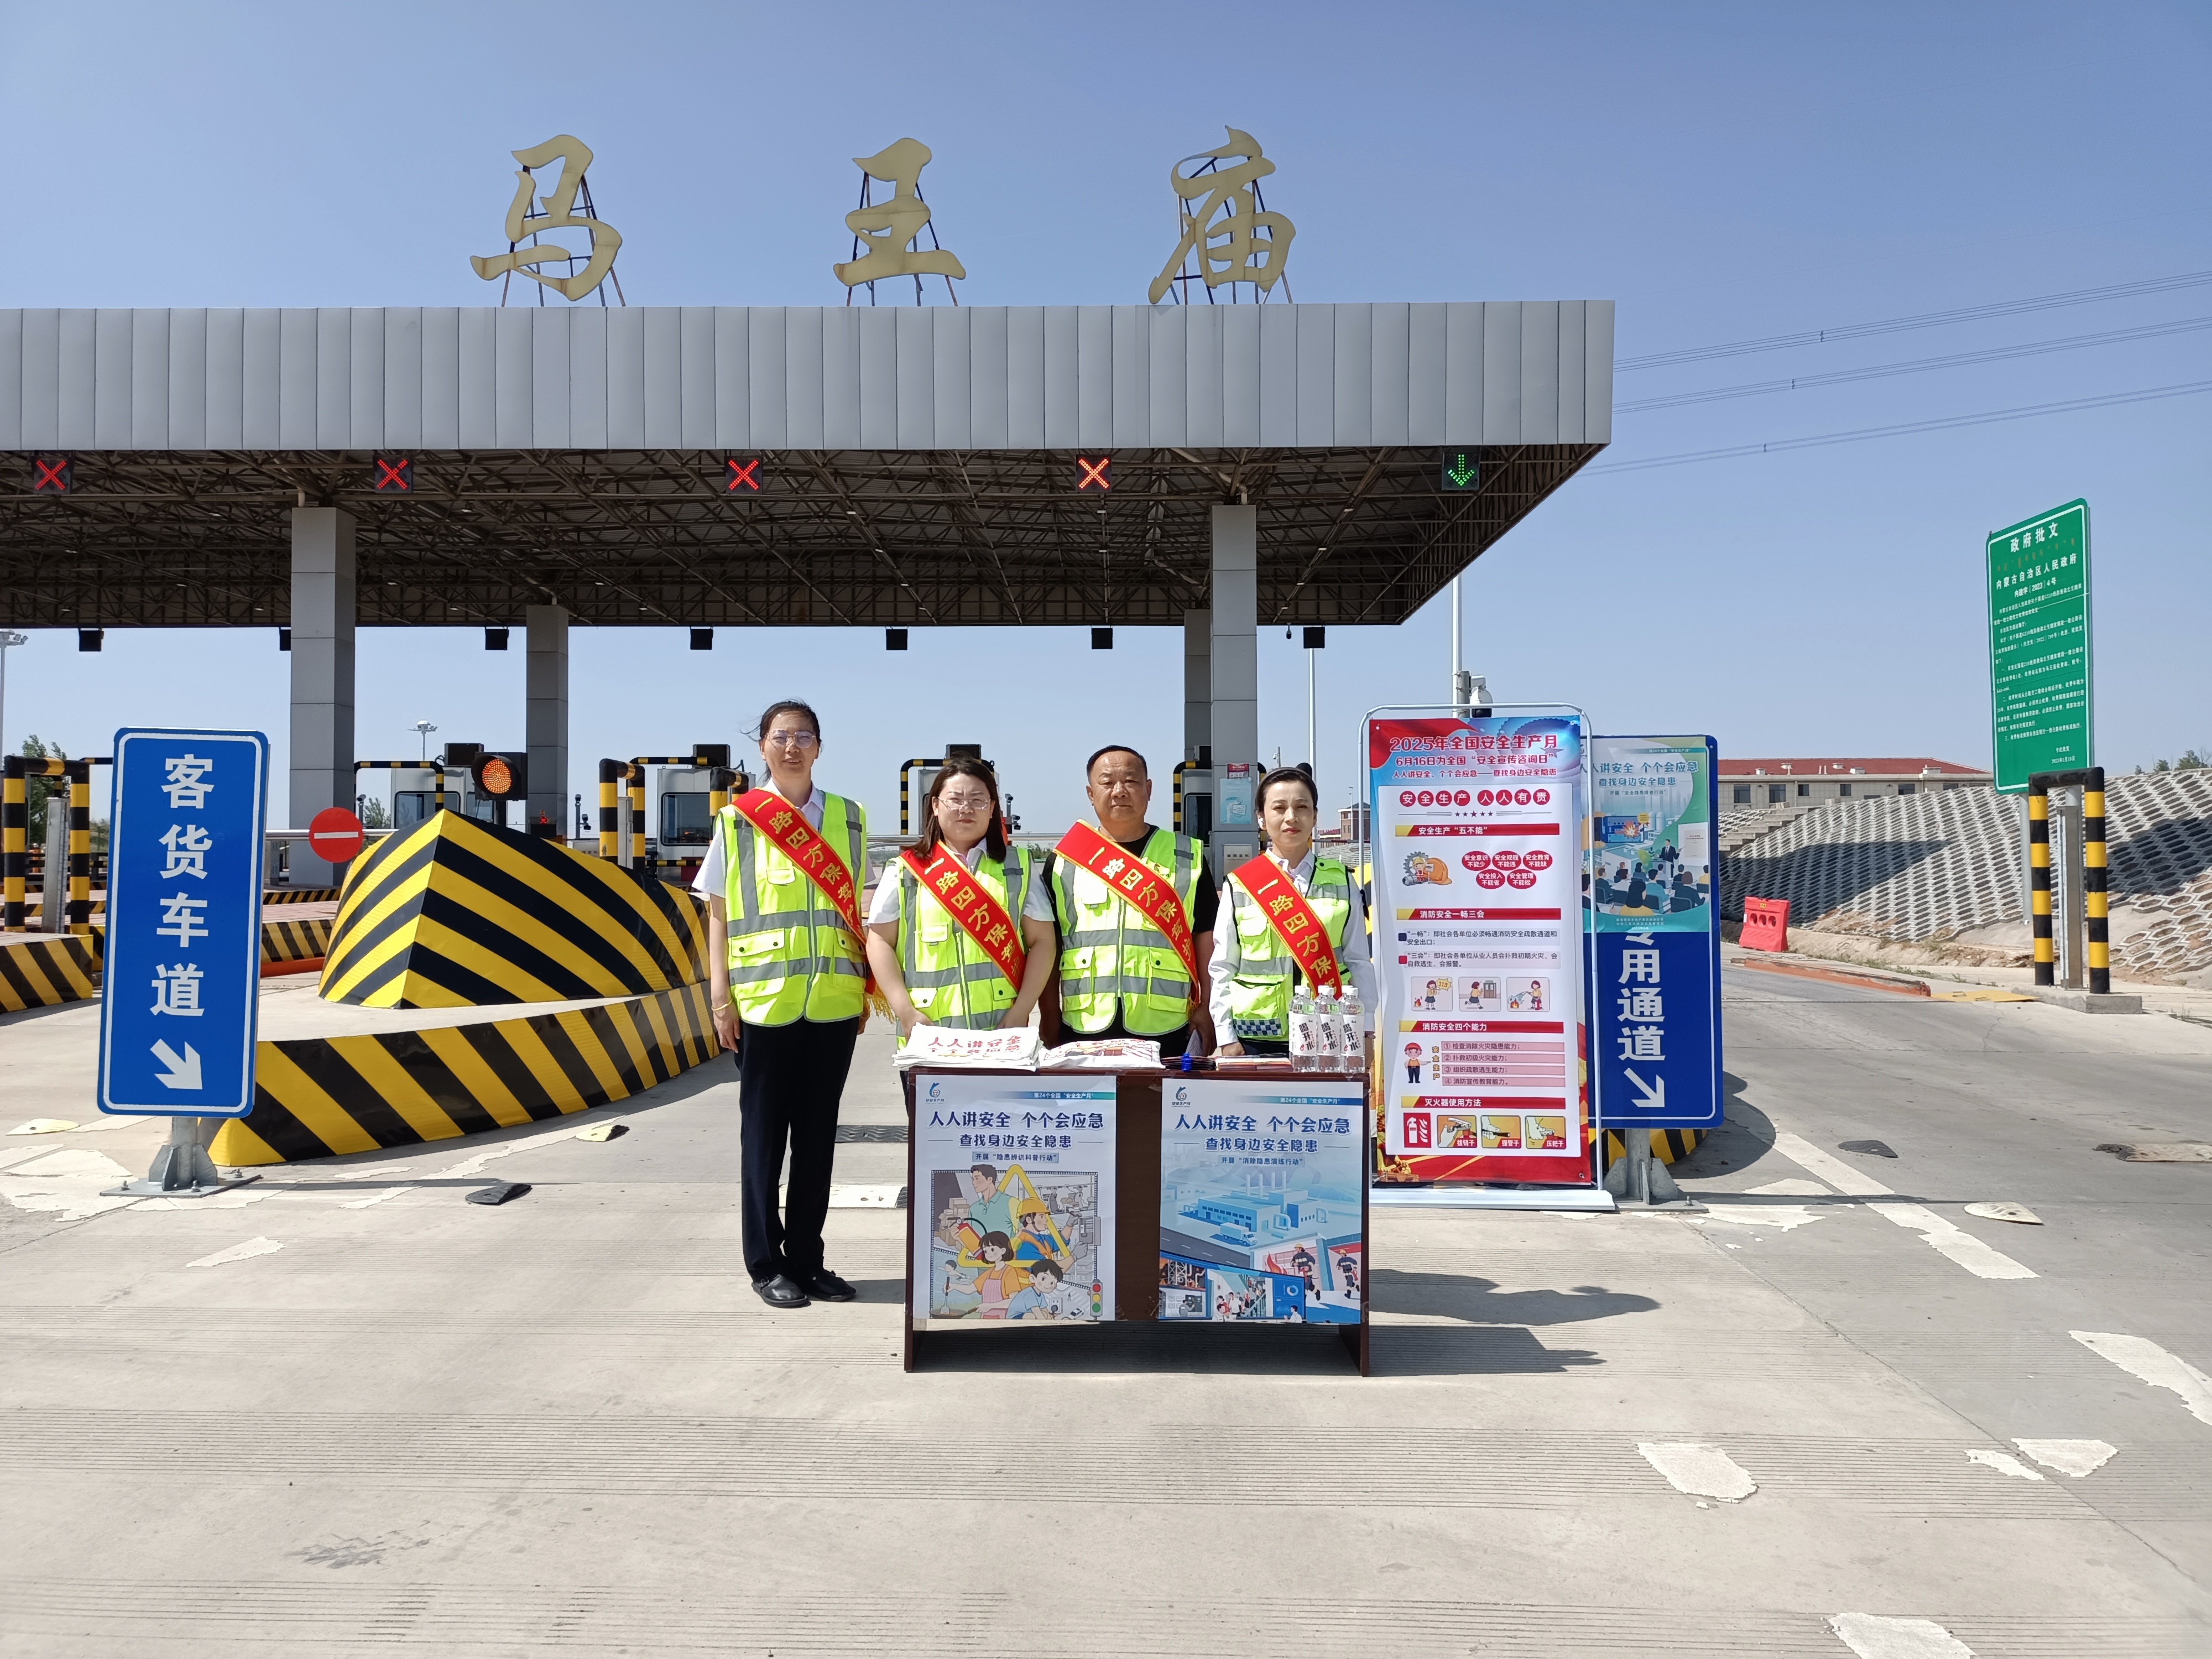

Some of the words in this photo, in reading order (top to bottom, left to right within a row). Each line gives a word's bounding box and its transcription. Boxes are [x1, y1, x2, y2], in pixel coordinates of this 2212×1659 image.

[470, 125, 1296, 305] 马王庙
[2010, 522, 2058, 552] 政府批文
[1996, 553, 2077, 590] 内蒙古自治区人民政府
[1389, 735, 1557, 752] 2025年全国安全生产月
[1579, 762, 1634, 774] 人人讲安全
[1641, 760, 1698, 773] 个个会应急
[1598, 777, 1676, 786] 查找身边安全隐患
[1402, 793, 1467, 804] 安全生产
[1480, 792, 1546, 803] 人人有责
[150, 754, 215, 1016] 客货车道
[1420, 910, 1485, 919] 消防安全一畅三会
[1422, 1022, 1487, 1031] 消防安全四个能力
[1425, 1098, 1481, 1107] 灭火器使用方法
[928, 1111, 1011, 1129] 人人讲安全
[1021, 1112, 1104, 1129] 个个会应急
[1175, 1114, 1257, 1131] 人人讲安全
[1267, 1116, 1350, 1134] 个个会应急
[959, 1134, 1072, 1149] 查找身边安全隐患
[1206, 1138, 1318, 1152] 查找身边安全隐患
